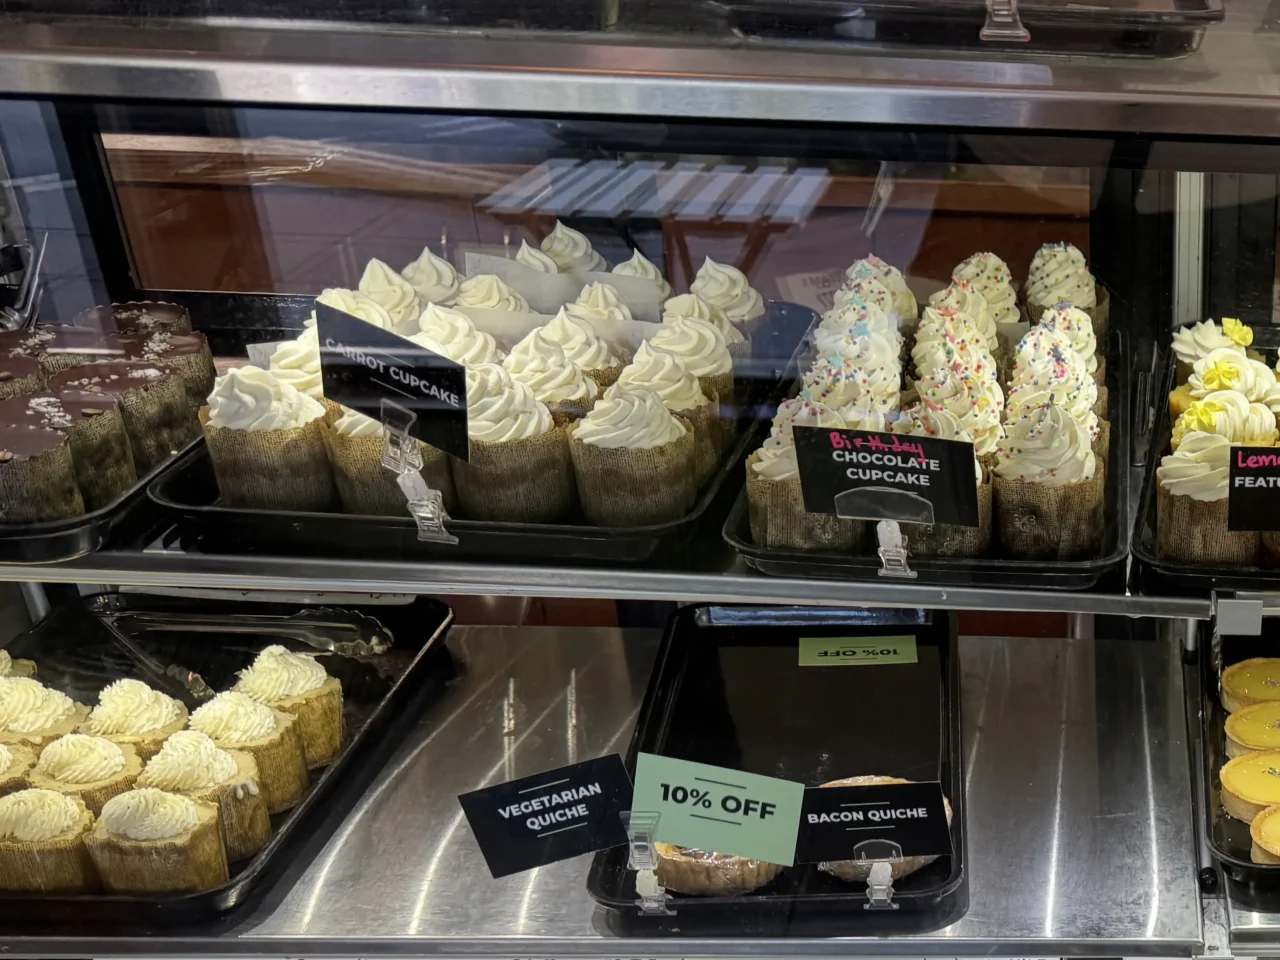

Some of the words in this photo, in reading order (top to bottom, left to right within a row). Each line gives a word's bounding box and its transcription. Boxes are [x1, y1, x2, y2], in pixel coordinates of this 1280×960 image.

[325, 338, 386, 374] CARROT
[389, 366, 460, 408] CUPCAKE
[829, 431, 926, 463] Birthday
[832, 450, 940, 471] CHOCOLATE
[846, 467, 930, 486] CUPCAKE
[862, 648, 900, 657] 10%
[497, 782, 602, 819] VEGETARIAN
[660, 783, 712, 809] 10%
[720, 795, 776, 819] OFF
[526, 803, 589, 830] QUICHE
[807, 811, 864, 824] BACON
[867, 807, 928, 821] QUICHE
